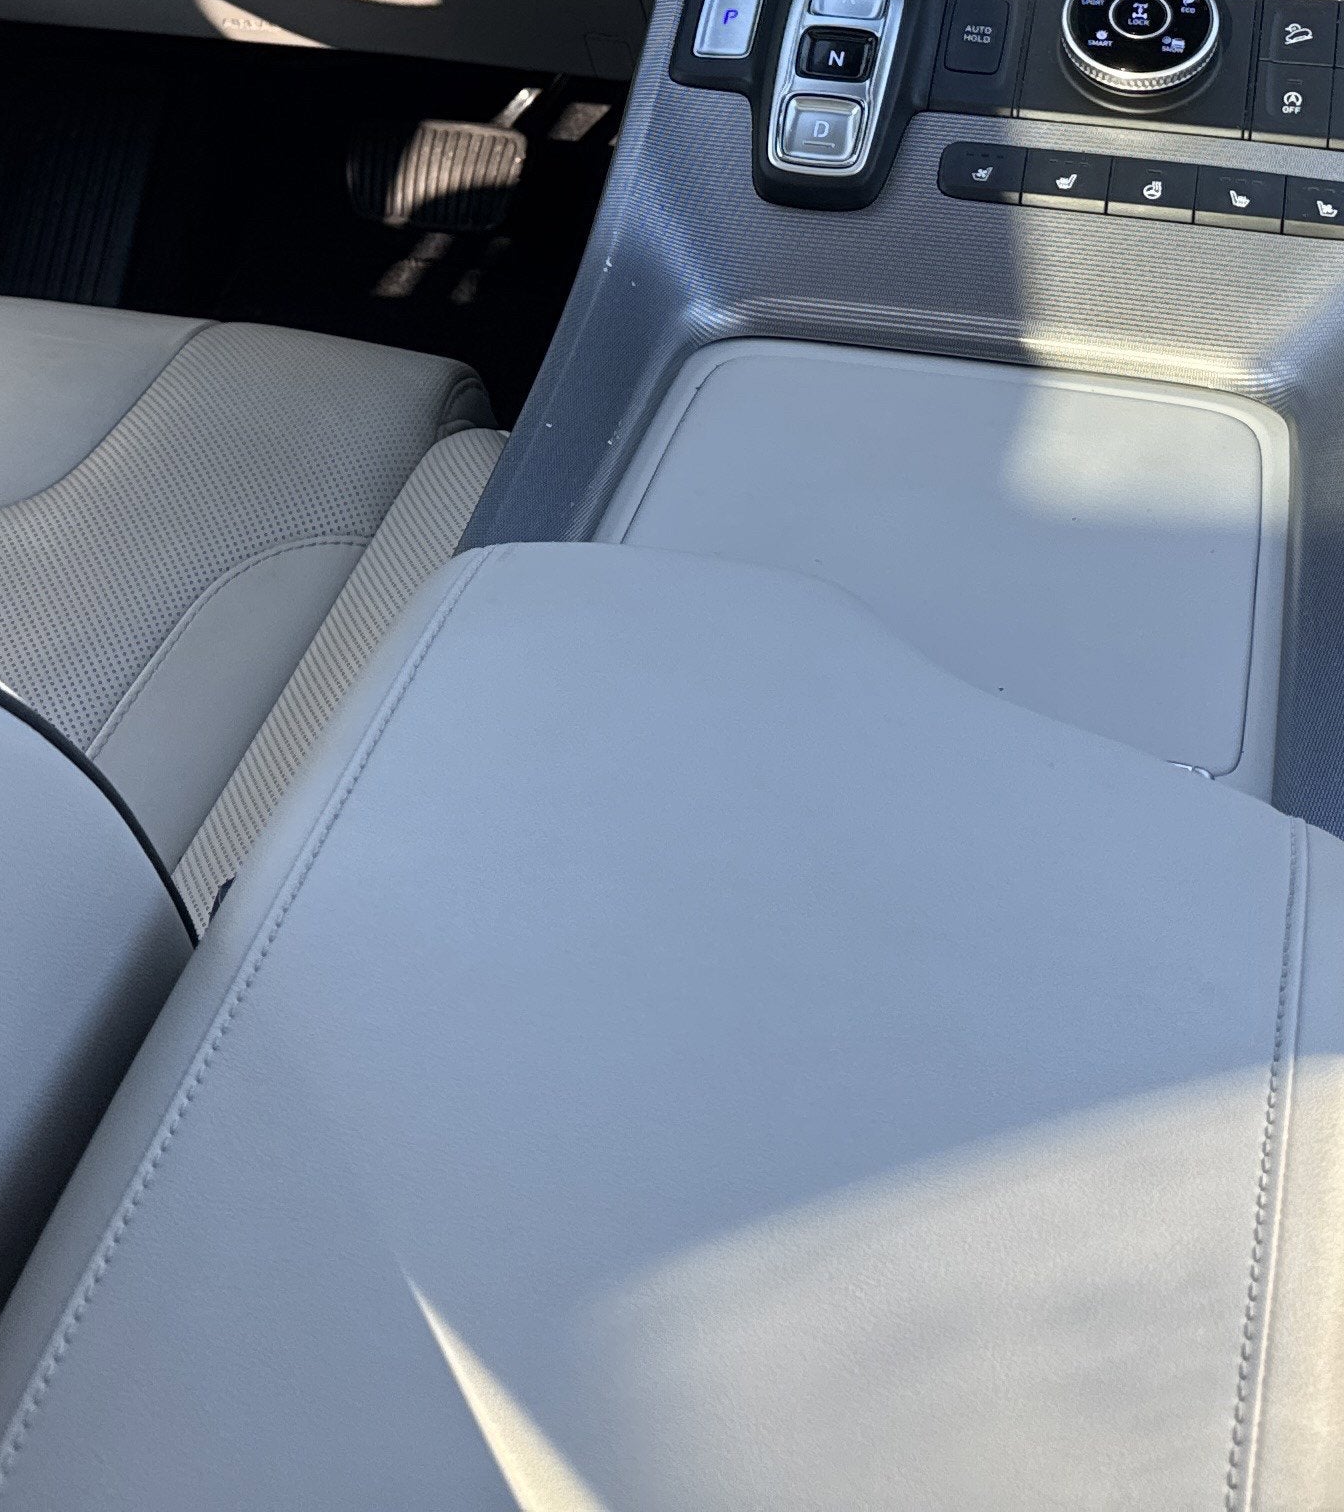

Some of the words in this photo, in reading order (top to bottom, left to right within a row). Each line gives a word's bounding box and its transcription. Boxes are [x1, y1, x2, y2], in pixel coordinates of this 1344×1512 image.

[1181, 6, 1196, 14] ECO
[723, 9, 739, 25] P
[1127, 18, 1150, 26] LOCK
[964, 24, 992, 35] AUTO
[963, 34, 991, 44] HOLD
[1088, 39, 1113, 47] SMART
[828, 50, 845, 67] N
[1282, 106, 1301, 115] OFF
[813, 120, 830, 138] D
